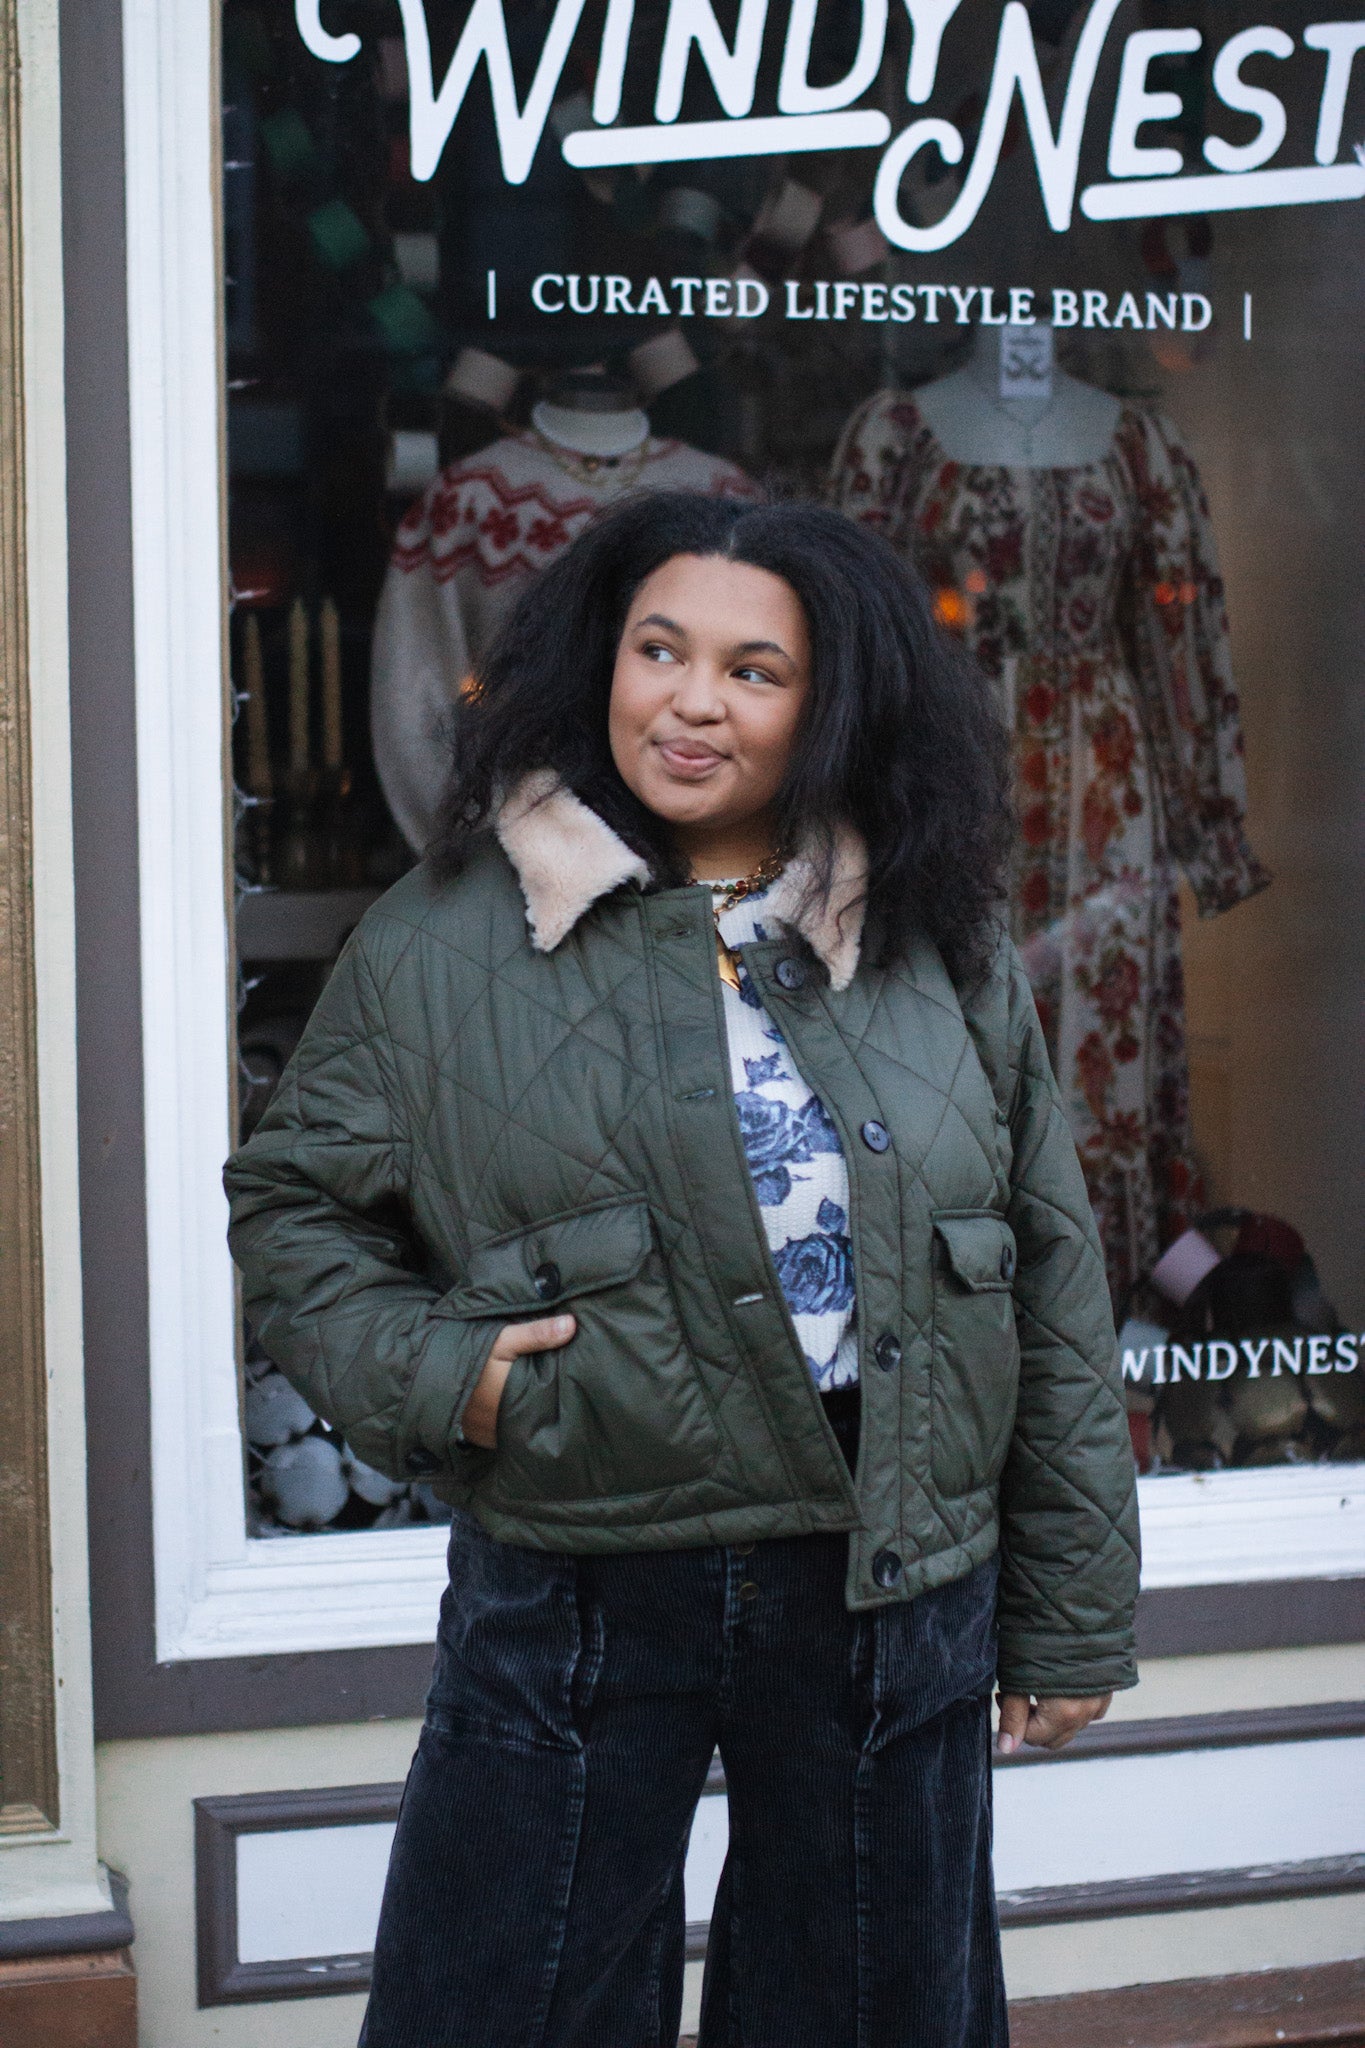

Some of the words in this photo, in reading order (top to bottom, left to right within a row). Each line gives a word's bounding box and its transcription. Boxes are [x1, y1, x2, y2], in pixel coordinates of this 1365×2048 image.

[874, 0, 1365, 252] NEST
[531, 273, 769, 318] CURATED
[785, 281, 1037, 325] LIFESTYLE
[1052, 289, 1213, 331] BRAND
[1122, 1332, 1365, 1384] WINDYNES
